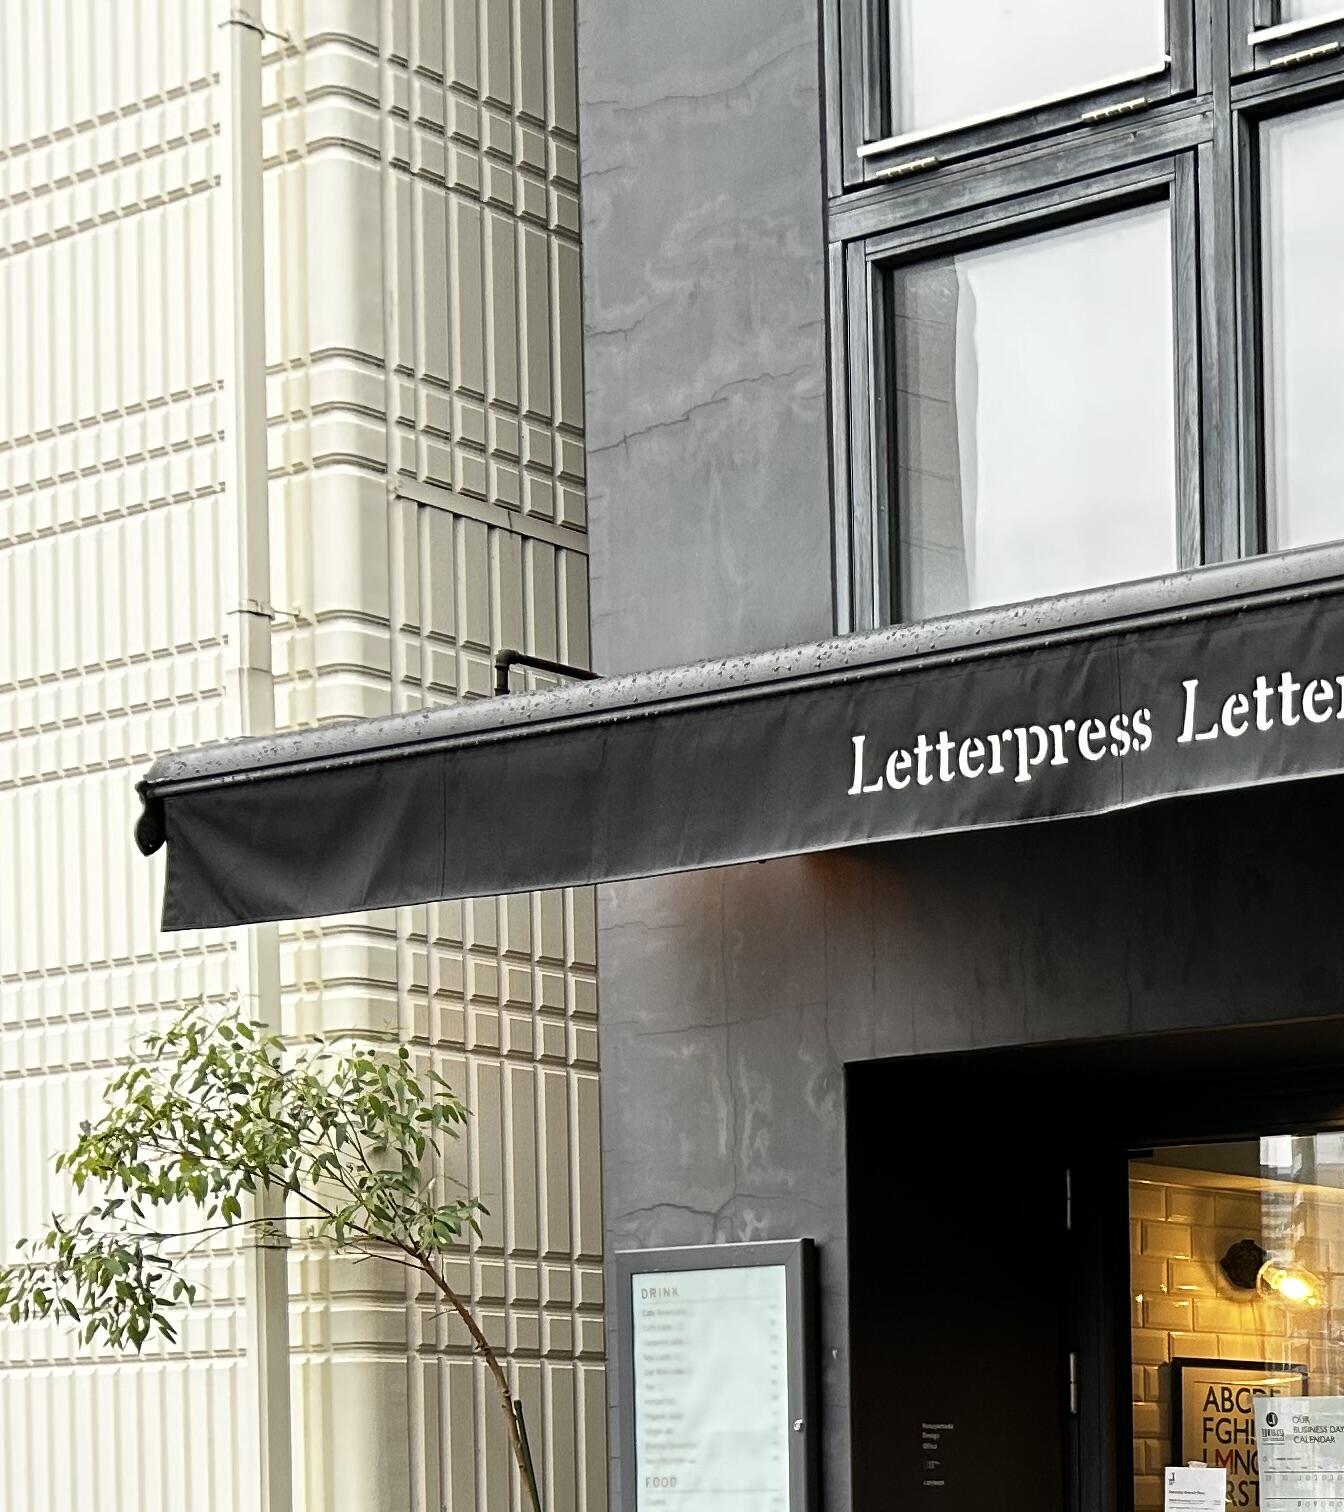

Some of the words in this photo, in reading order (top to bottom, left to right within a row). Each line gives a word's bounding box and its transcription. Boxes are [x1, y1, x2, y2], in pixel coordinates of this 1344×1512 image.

[848, 703, 1153, 796] Letterpress
[641, 1286, 679, 1300] DRINK
[645, 1476, 678, 1489] FOOD
